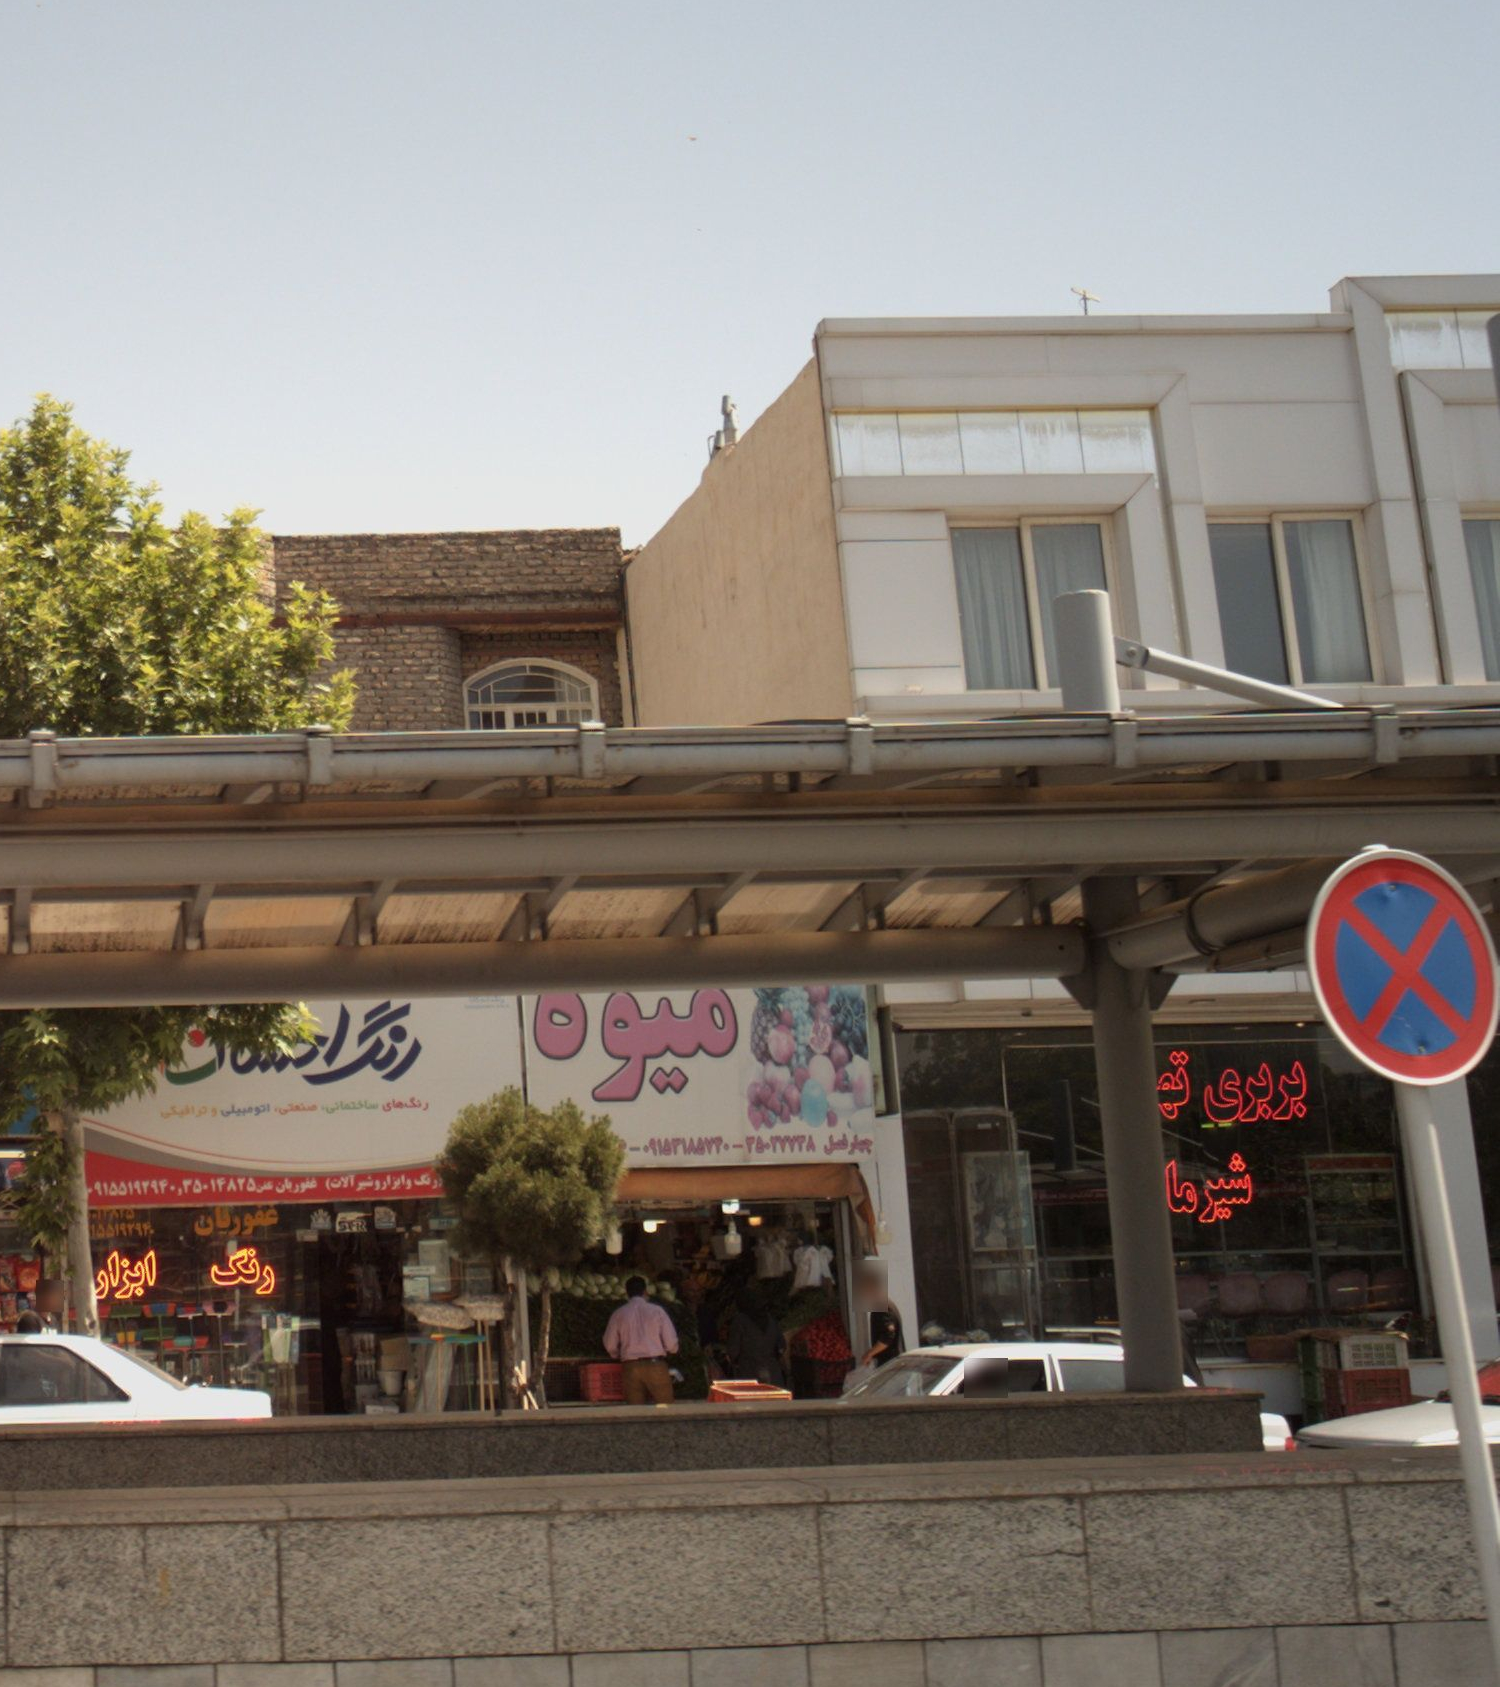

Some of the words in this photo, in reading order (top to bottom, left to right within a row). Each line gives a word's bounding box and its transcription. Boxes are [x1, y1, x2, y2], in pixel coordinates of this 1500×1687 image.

[302, 1000, 422, 1084] رنگ
[533, 986, 739, 1102] میوه
[1203, 1061, 1307, 1123] بربری
[93, 1249, 157, 1301] ابزار
[210, 1247, 276, 1296] رنگ
